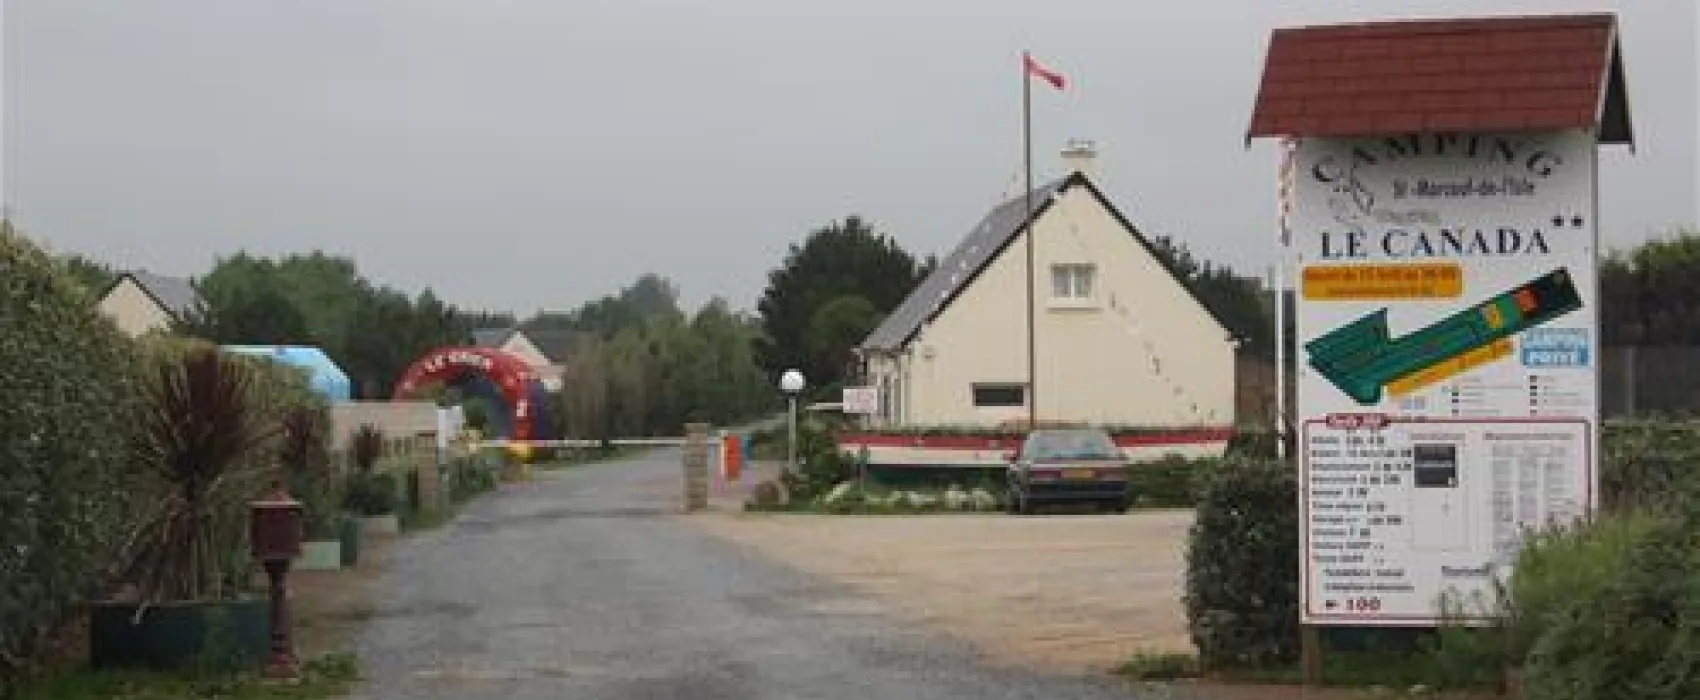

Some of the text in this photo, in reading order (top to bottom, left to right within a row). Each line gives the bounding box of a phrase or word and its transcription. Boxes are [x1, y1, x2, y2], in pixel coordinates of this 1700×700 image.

[1310, 134, 1564, 184] CAMPING
[1321, 228, 1551, 258] LE CANADA
